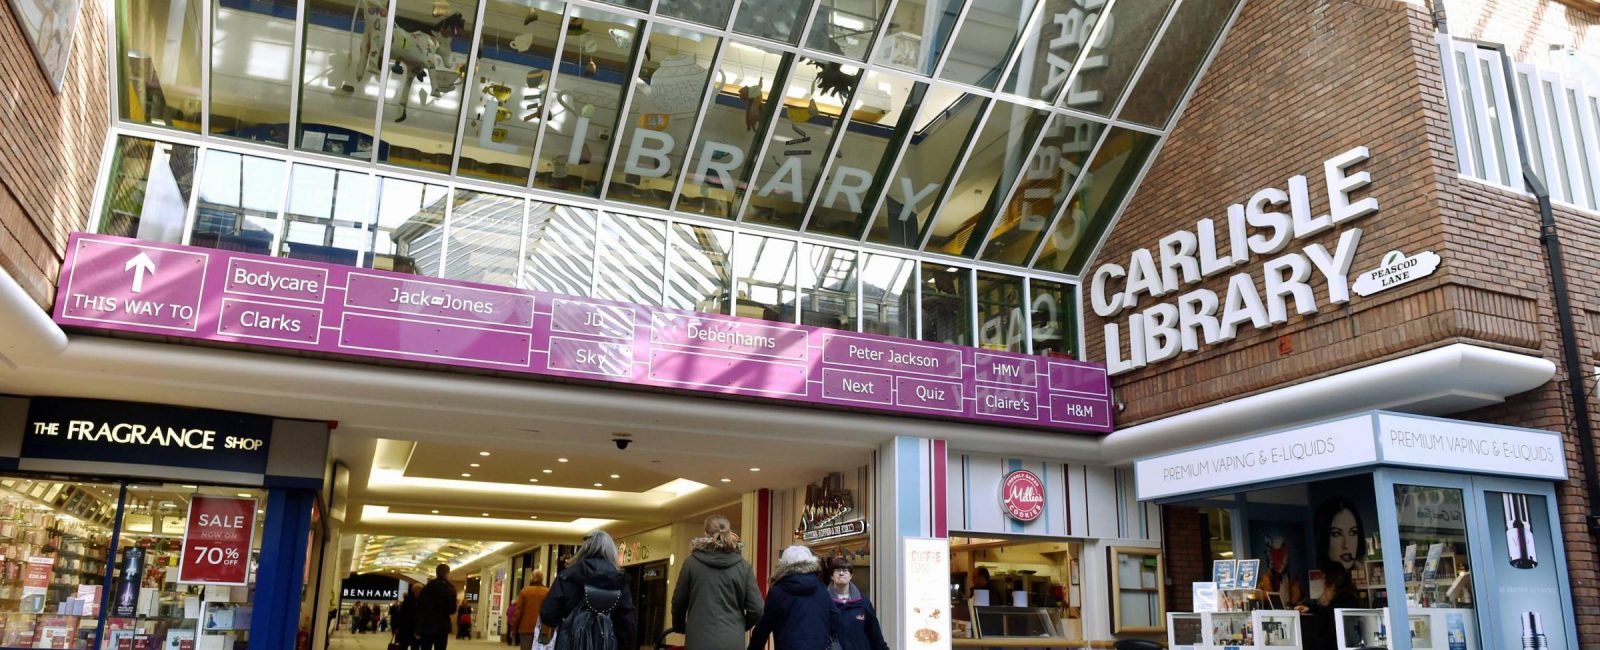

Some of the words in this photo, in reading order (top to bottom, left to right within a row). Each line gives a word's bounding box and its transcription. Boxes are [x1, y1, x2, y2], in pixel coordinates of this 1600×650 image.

[477, 99, 940, 222] LIBRARY
[1090, 145, 1379, 317] CARLISLE
[234, 267, 319, 294] Bodycare
[1371, 258, 1418, 281] PEASCOD
[1381, 271, 1410, 287] LANE
[72, 293, 117, 313] THIS
[123, 299, 163, 317] WAY
[169, 304, 194, 321] TO
[389, 287, 433, 307] Jack
[441, 295, 494, 315] Jones
[1104, 227, 1363, 376] LIBRARY
[240, 310, 302, 332] Clarks
[583, 311, 604, 327] JD
[687, 325, 776, 348] Debenhams
[575, 348, 607, 368] Sky
[849, 345, 885, 362] Peter
[889, 347, 939, 368] Jackson
[992, 363, 1020, 377] HMV
[842, 377, 875, 395] Next
[916, 386, 945, 402] Quiz
[1066, 403, 1093, 418] H&M
[33, 421, 59, 437] THE
[67, 420, 215, 450] FRAGRANCE
[225, 435, 263, 451] SHOP
[1390, 429, 1444, 451] PREMIUM
[1445, 435, 1489, 455] VAPING
[1491, 441, 1501, 455] &
[1503, 441, 1555, 463] E-LIQUIDS
[1163, 461, 1210, 483] PREMIUM
[1212, 452, 1257, 473] VAPING
[1258, 450, 1268, 464] &
[1271, 437, 1335, 464] E-LIQUIDS
[198, 514, 245, 529] SALE
[1009, 504, 1042, 518] COOKIES
[200, 531, 222, 539] NOW
[224, 532, 238, 540] ON
